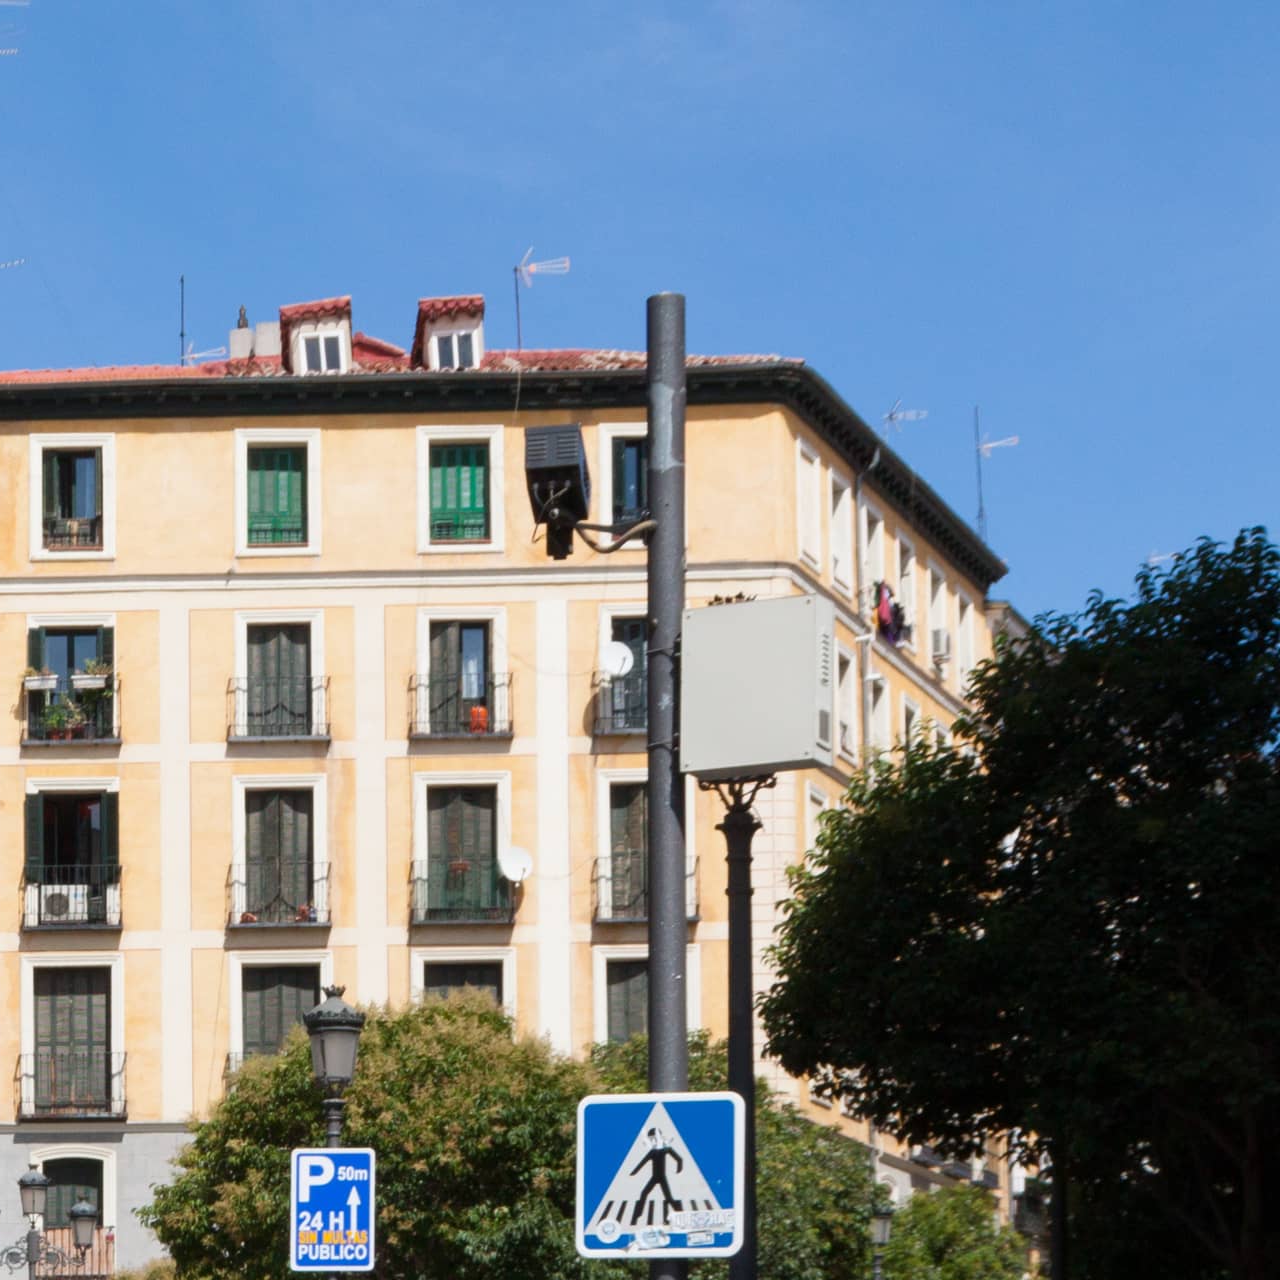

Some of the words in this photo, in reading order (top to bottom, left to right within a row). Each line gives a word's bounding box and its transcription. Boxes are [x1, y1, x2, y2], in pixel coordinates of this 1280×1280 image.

[298, 1156, 335, 1203] P
[338, 1166, 368, 1181] 50m
[298, 1210, 324, 1232] 24
[329, 1210, 345, 1231] H
[298, 1230, 318, 1244] SIN
[322, 1230, 368, 1244] MULTAS
[298, 1244, 368, 1261] PUBLICO
